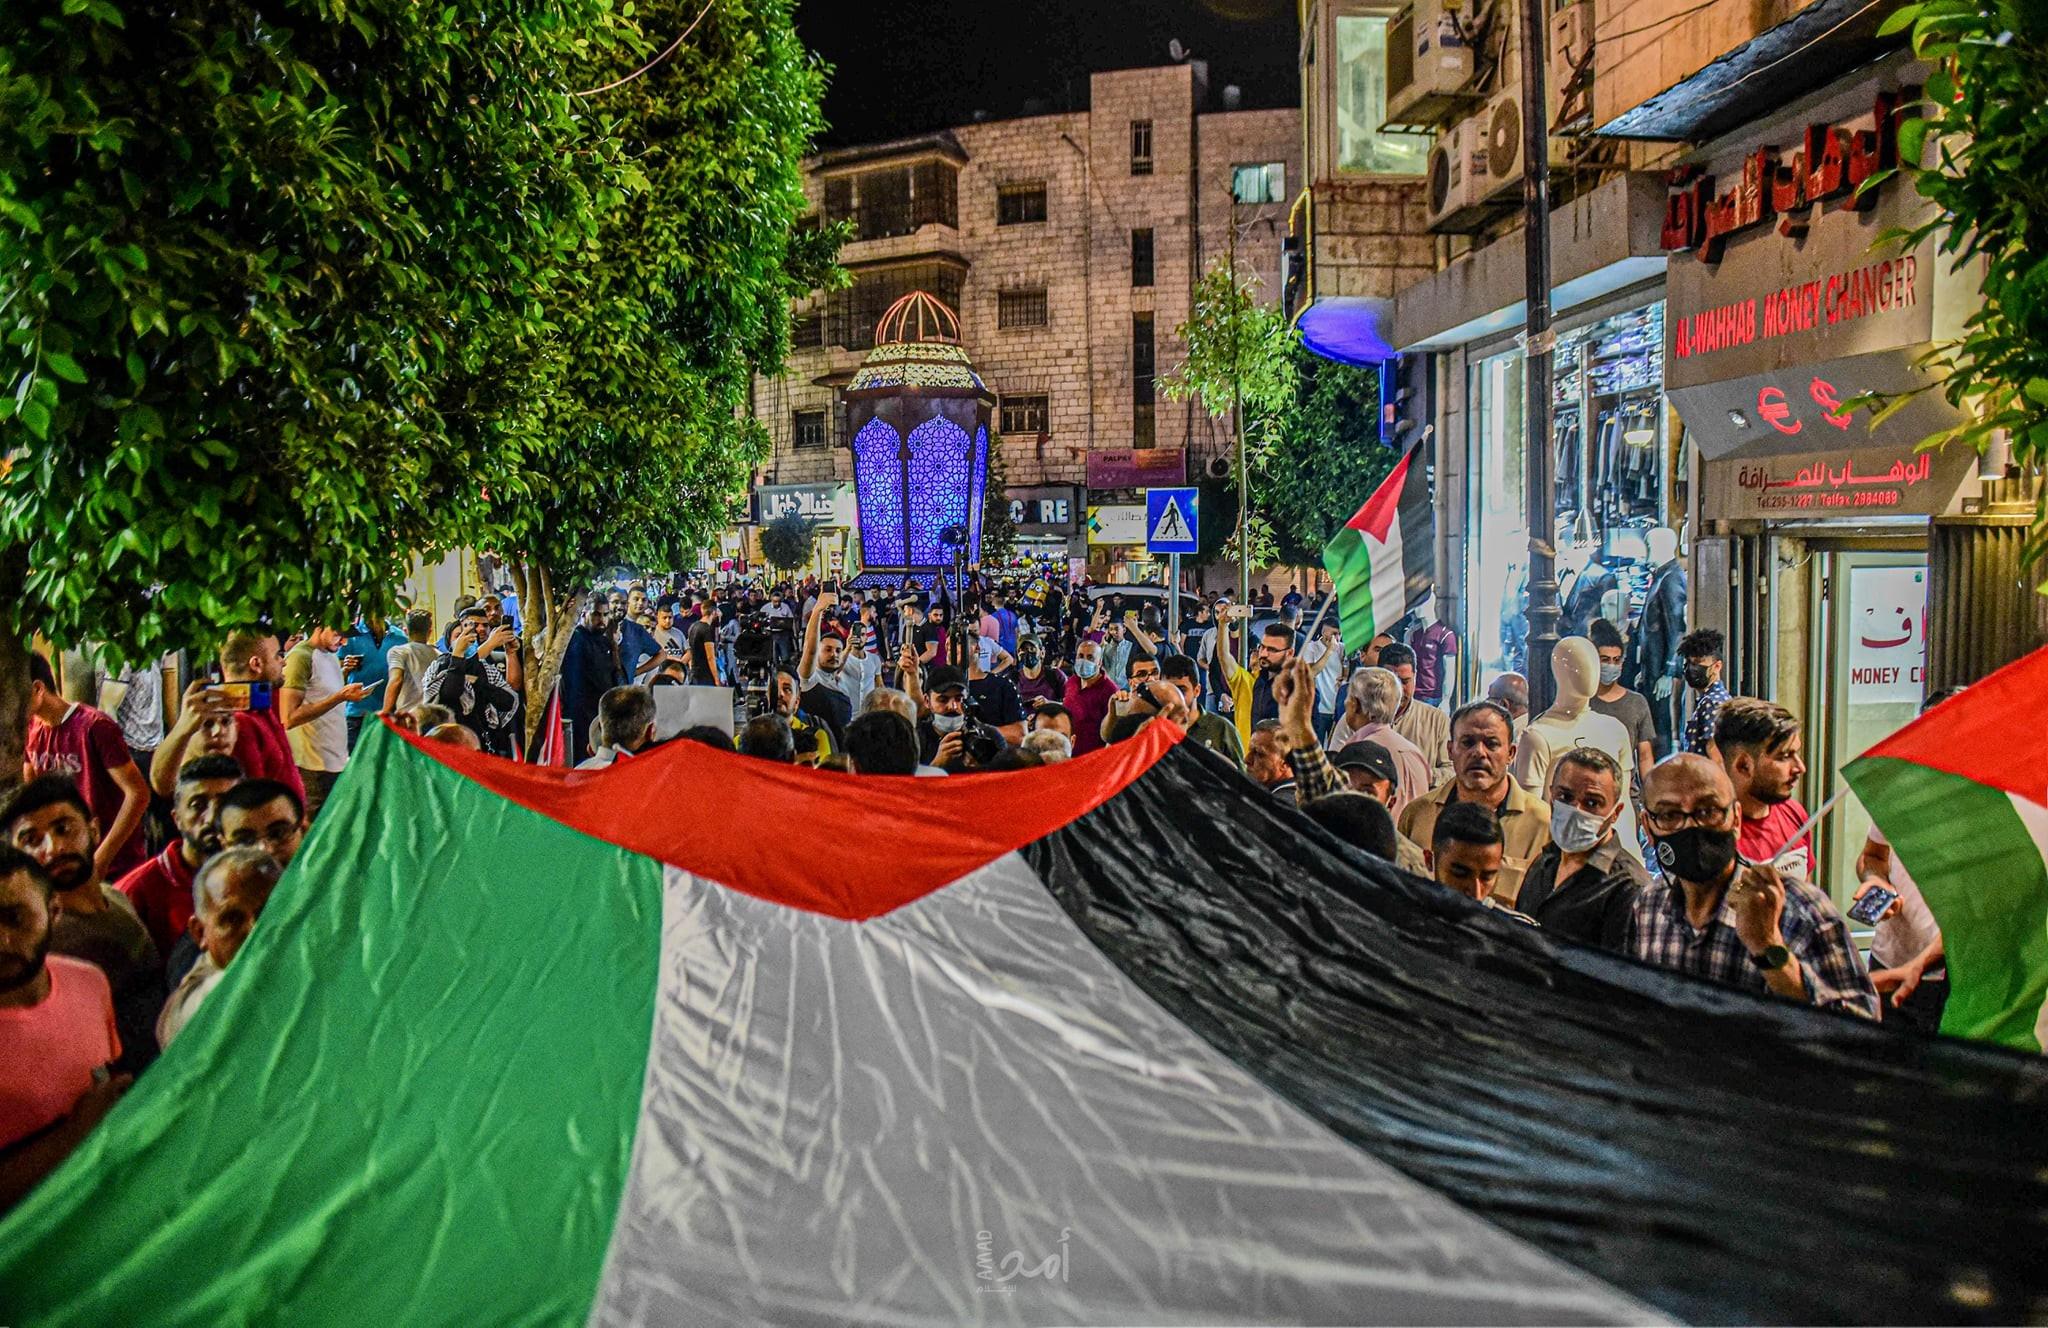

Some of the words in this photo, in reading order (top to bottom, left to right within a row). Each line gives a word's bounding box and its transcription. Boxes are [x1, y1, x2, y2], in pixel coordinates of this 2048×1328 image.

[1675, 298, 1757, 359] AL-WAHHAB
[1763, 278, 1821, 339] MONEY
[1826, 255, 1917, 325] CHANGER
[1738, 462, 1826, 492] للصرافة
[1828, 453, 1930, 489] الوهاب
[1851, 666, 1900, 685] MONEY
